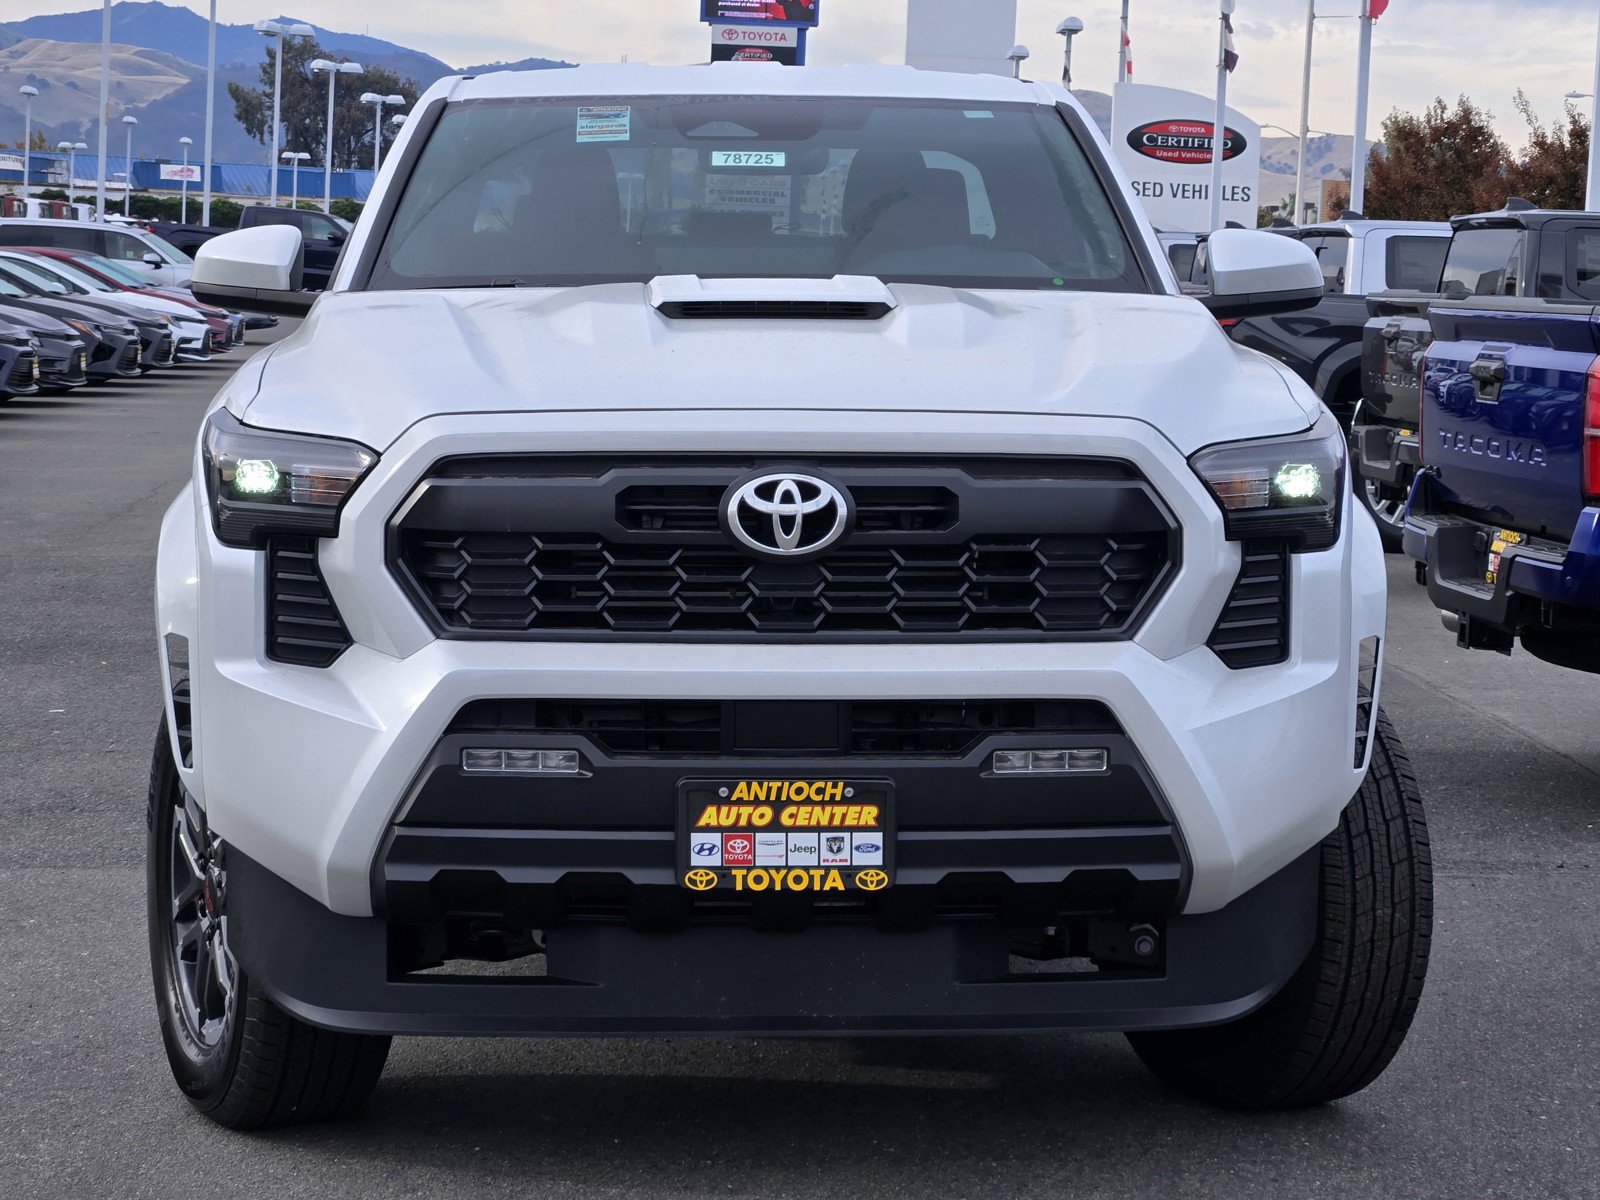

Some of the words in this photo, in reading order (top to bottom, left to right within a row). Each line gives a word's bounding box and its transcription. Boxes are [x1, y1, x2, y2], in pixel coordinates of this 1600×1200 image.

[741, 31, 787, 42] TOYOTA
[1142, 133, 1232, 149] CERTIFID
[722, 153, 775, 164] 78725
[1181, 151, 1213, 159] Vehicle
[708, 188, 787, 198] COMMERCIAL
[1131, 180, 1164, 198] SED
[1170, 182, 1251, 202] VEHILES
[719, 195, 776, 204] VEHICLES
[1439, 428, 1547, 467] TACOMA
[731, 781, 844, 801] ANTIOCH
[695, 804, 774, 827] AUTO
[778, 804, 880, 827] CENTER
[789, 844, 817, 855] Jeep
[858, 843, 876, 853] Ford
[731, 869, 845, 891] TOYOTA
